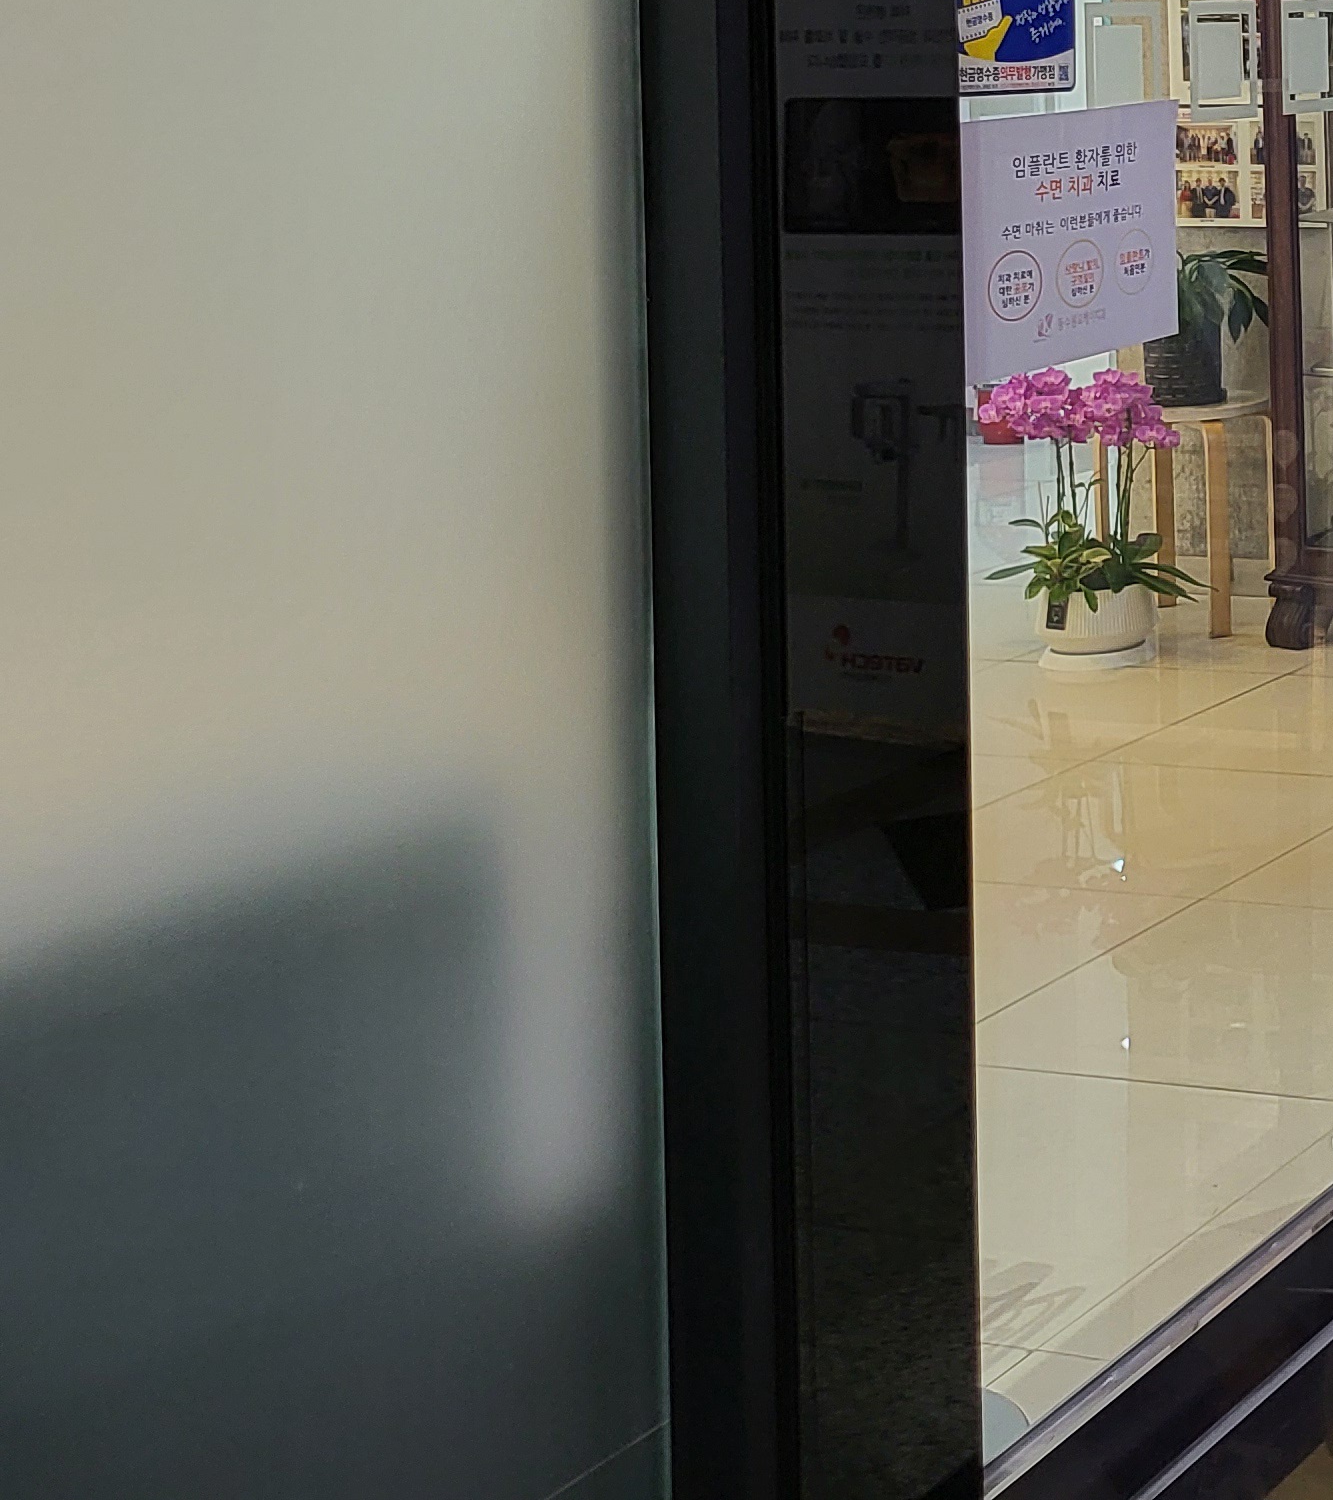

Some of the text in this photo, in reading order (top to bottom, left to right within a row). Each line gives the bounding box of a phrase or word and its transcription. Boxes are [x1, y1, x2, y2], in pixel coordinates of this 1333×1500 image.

[1013, 142, 1137, 179] 임플란트 환자를 위한
[1035, 170, 1121, 202] 수면 치과 치료
[1002, 225, 1021, 241] 수면
[1025, 220, 1054, 236] 마취는
[1060, 209, 1110, 231] 이런분들에게
